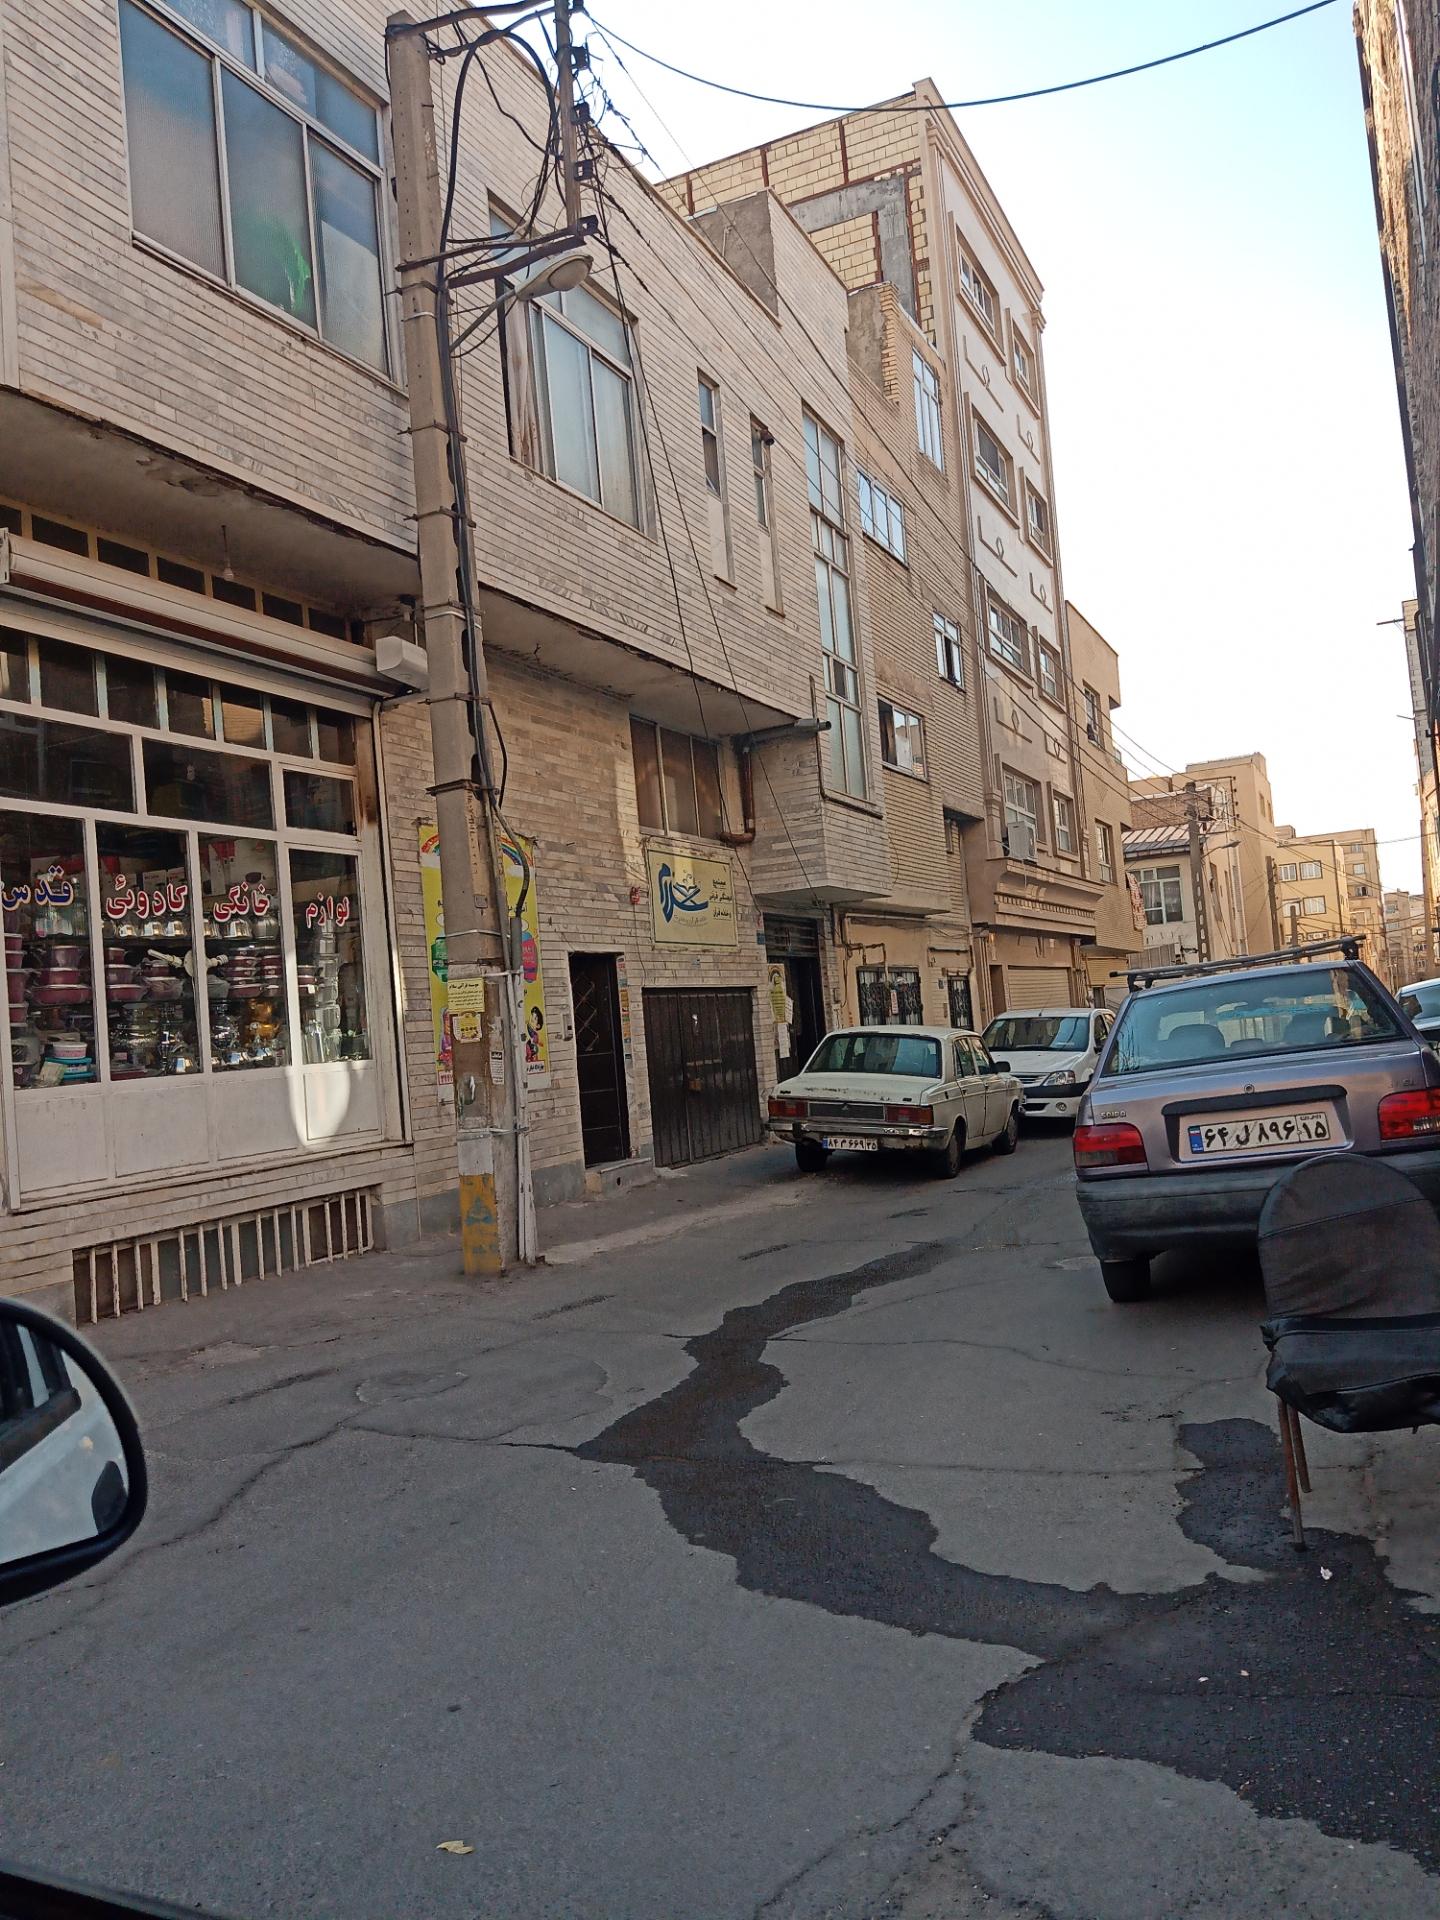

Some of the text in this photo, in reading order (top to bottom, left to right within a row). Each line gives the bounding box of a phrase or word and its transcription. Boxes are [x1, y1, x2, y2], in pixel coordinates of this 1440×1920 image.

[0, 864, 74, 911] قدس
[213, 881, 270, 922] خانگی
[305, 892, 350, 928] لوازم
